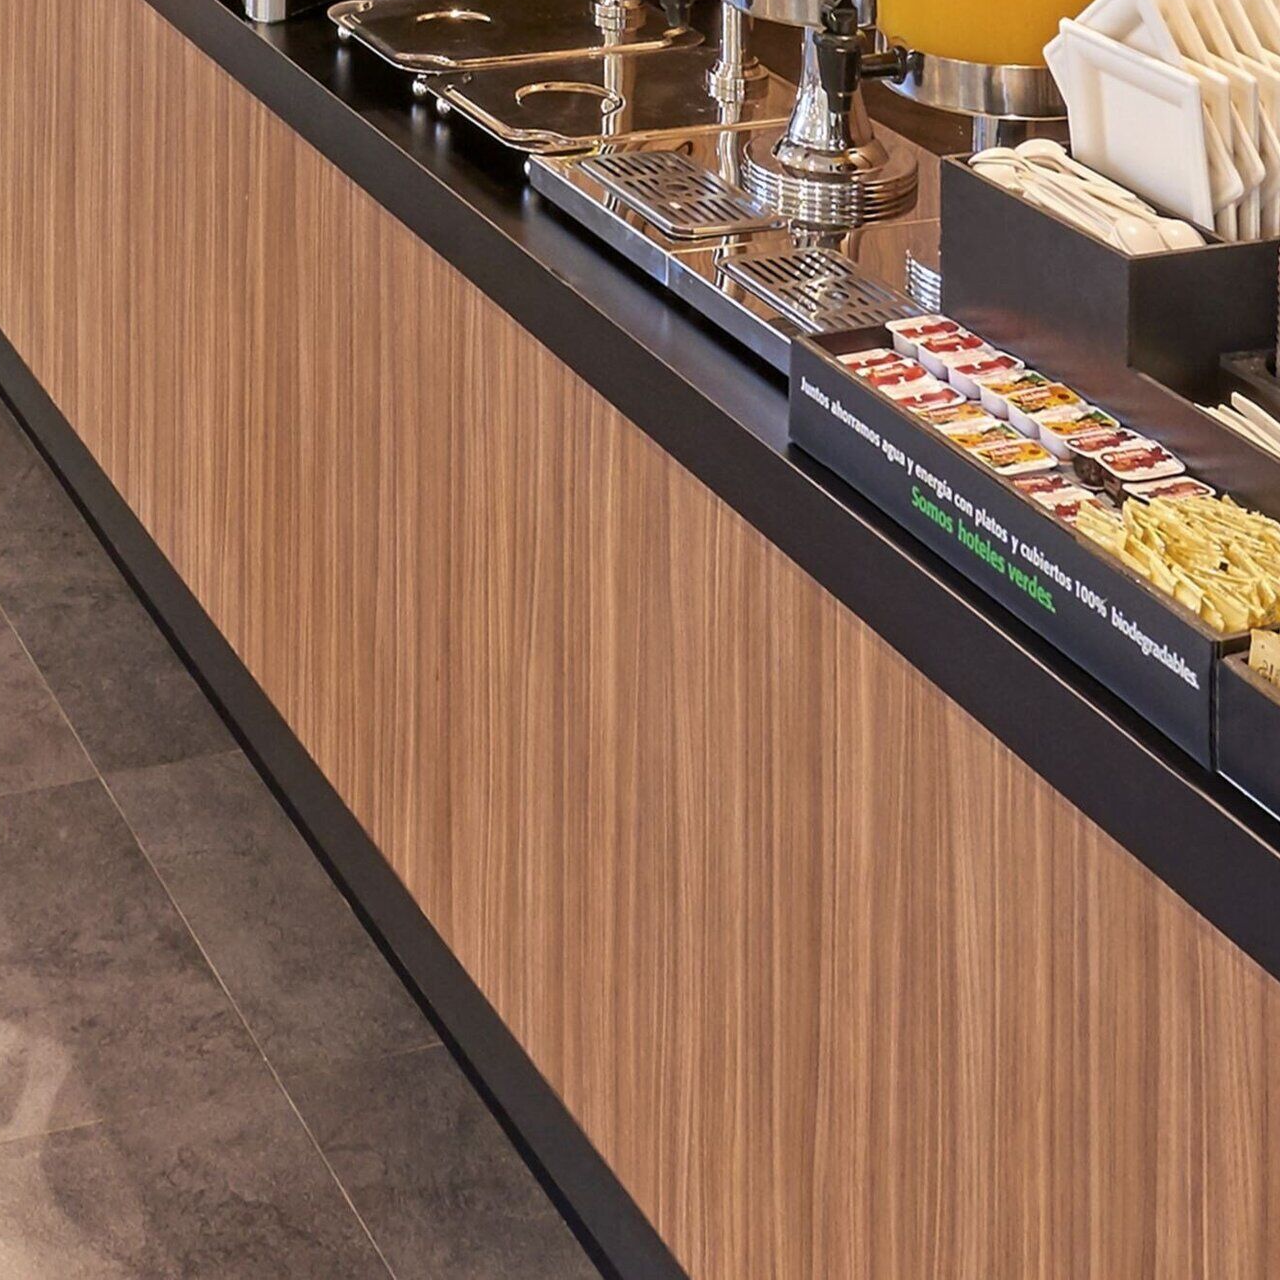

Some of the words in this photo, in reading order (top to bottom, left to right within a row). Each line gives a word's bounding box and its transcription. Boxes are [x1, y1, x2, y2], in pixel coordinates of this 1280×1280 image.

[800, 376, 830, 411] Juntos
[830, 399, 881, 449] ahorramos
[881, 438, 906, 468] agua
[905, 458, 916, 476] y
[914, 461, 954, 502] energía
[952, 493, 974, 518] con
[974, 506, 1009, 543] platos
[1010, 535, 1021, 556] y
[1019, 541, 1073, 593] cubiertos
[1074, 580, 1109, 620] 100%
[1110, 605, 1201, 691] biodegradables.
[910, 485, 955, 535] Somos
[958, 518, 1007, 576] hoteles
[1007, 561, 1057, 615] verdes.
